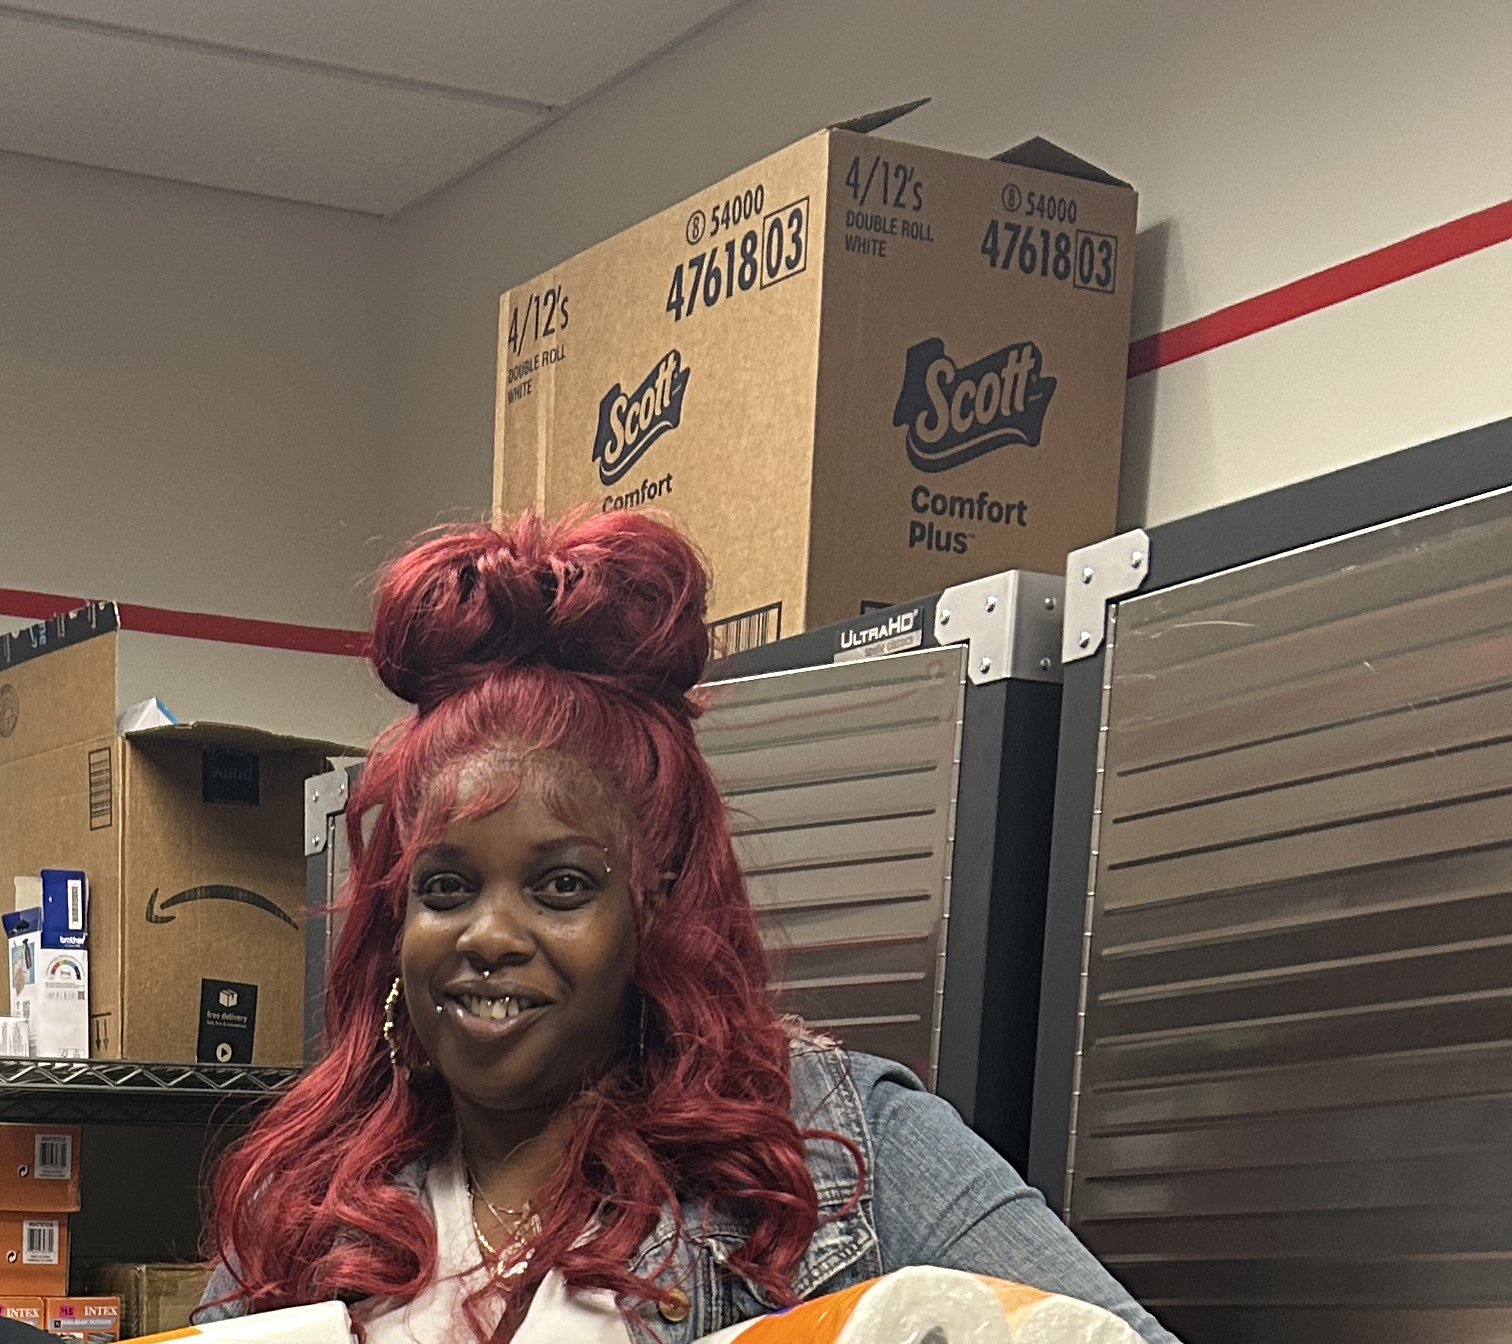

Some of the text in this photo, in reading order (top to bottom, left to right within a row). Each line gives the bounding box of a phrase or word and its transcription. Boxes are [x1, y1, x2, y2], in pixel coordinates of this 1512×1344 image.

[845, 156, 922, 213] 4/12's
[710, 185, 765, 222] 54000
[1026, 191, 1078, 223] 54000
[846, 209, 934, 243] DOUBLE ROLL
[845, 235, 887, 259] WHITE
[507, 285, 570, 356] 4/12's
[507, 343, 566, 385] DOUBLE ROLL
[507, 381, 533, 406] WHITE
[605, 350, 678, 466] Scott
[915, 343, 1036, 443] Scott
[603, 473, 673, 514] Comfort
[911, 486, 1028, 528] Comfort
[909, 520, 969, 555] Plus
[6, 1306, 40, 1318] INTEX
[84, 1306, 118, 1317] INTEX
